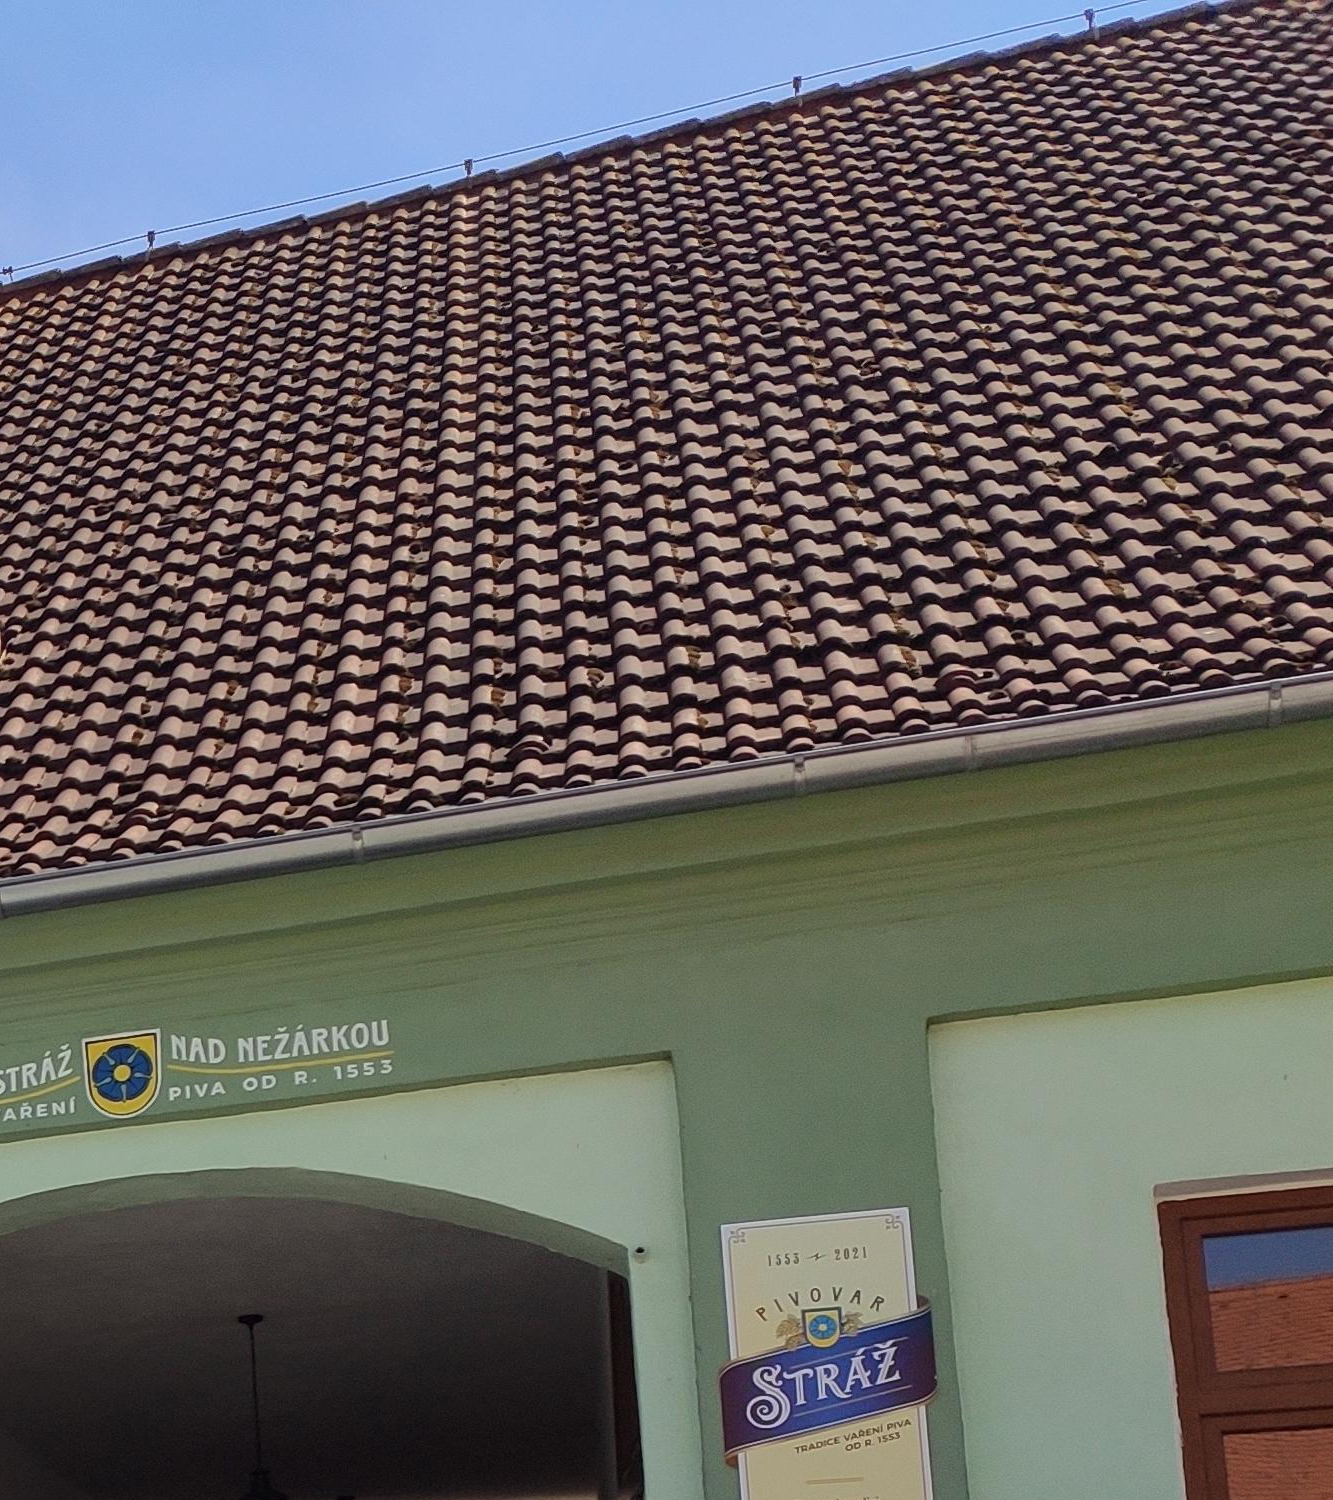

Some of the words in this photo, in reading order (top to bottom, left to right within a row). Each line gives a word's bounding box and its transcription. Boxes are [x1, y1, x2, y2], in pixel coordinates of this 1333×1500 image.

[169, 1034, 228, 1064] NAD
[237, 1019, 390, 1063] NEŽÁRKOU
[169, 1079, 226, 1102] PIVA
[242, 1072, 277, 1092] OD
[294, 1069, 318, 1087] R.
[334, 1058, 394, 1081] 1553
[767, 1253, 800, 1266] 1553
[834, 1246, 868, 1260] 2021
[755, 1286, 885, 1322] PIVOVAR
[746, 1340, 901, 1429] STRÁŽ
[794, 1435, 841, 1454] TRADICE
[844, 1424, 883, 1441] VAŘENÍ
[887, 1419, 911, 1431] PIVA
[845, 1441, 861, 1451] OD
[877, 1432, 900, 1443] 1553
